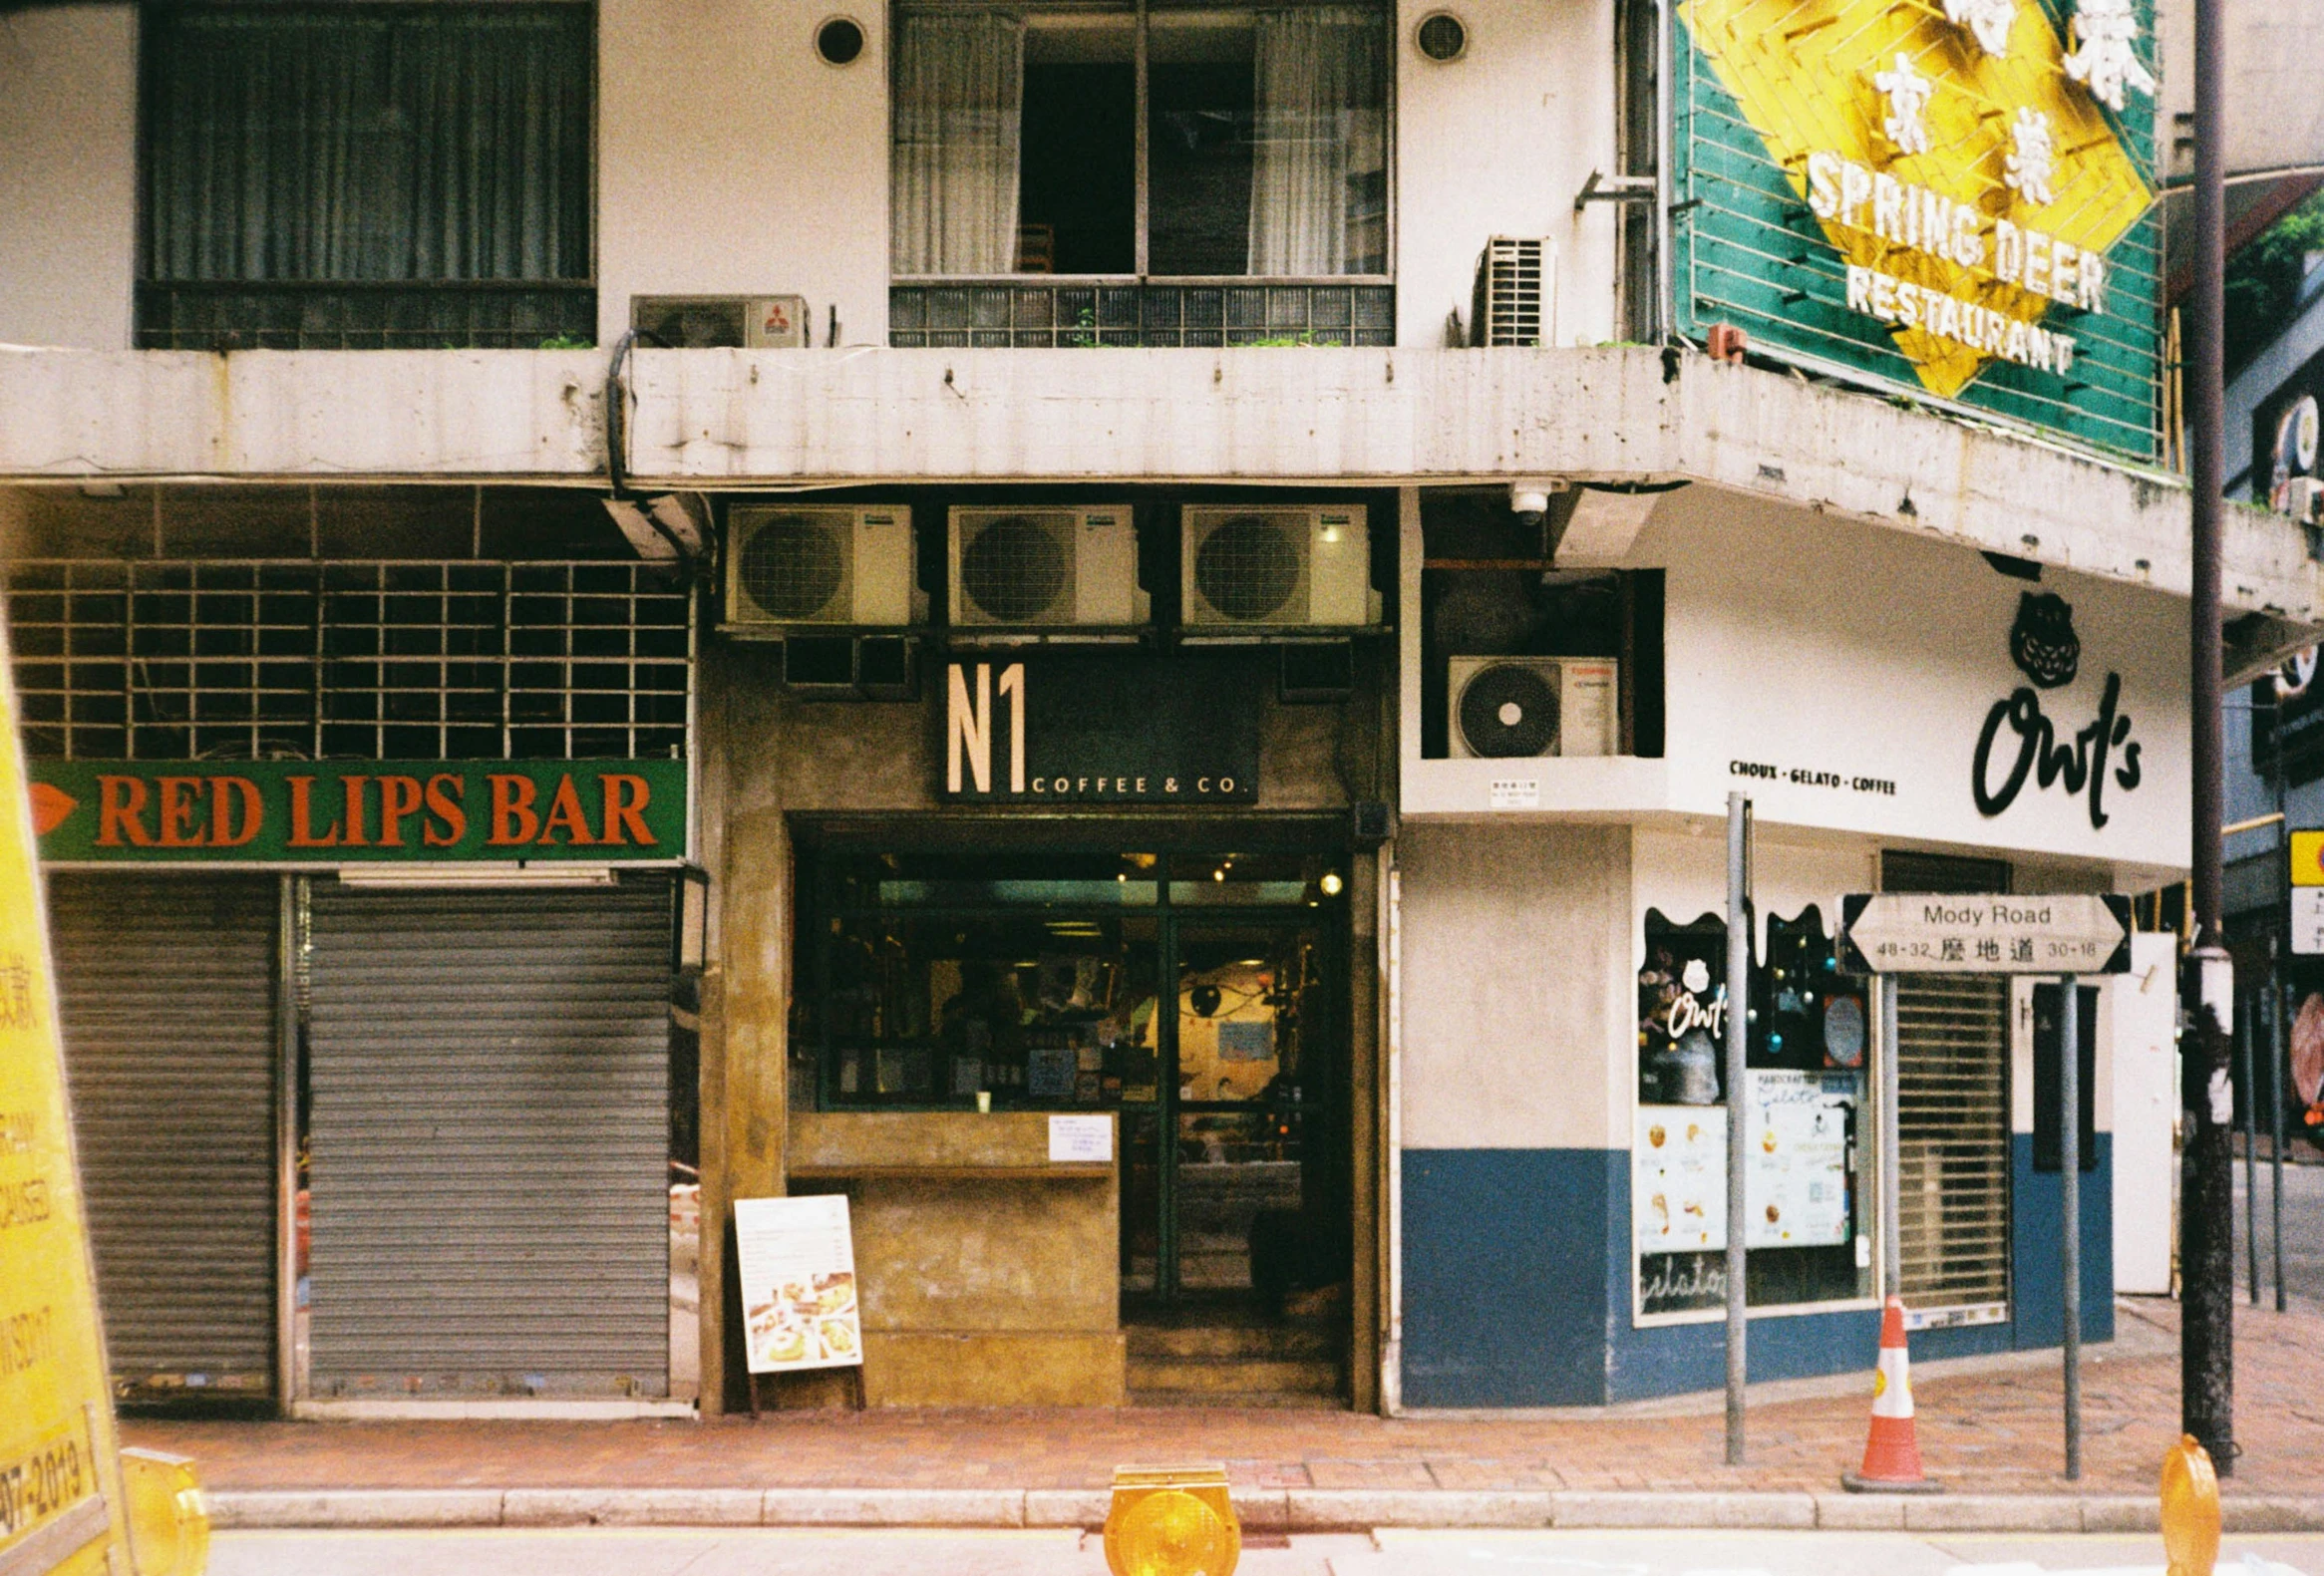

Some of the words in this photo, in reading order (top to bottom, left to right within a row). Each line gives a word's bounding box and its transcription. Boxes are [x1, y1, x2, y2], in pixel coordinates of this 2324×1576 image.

[1808, 150, 1985, 267] SPRING
[1996, 217, 2105, 314] DEER
[1847, 264, 2076, 376] RESTAURANT
[947, 663, 1025, 793] N1
[1032, 778, 1147, 793] COFFEE
[1165, 778, 1179, 793] &
[1197, 778, 1248, 793] CO.
[1972, 672, 2142, 829] Owl's
[95, 775, 263, 848] RED
[286, 774, 467, 848] LIPS
[487, 773, 658, 846] BAR
[1729, 760, 1777, 780] CHOUX
[1790, 769, 1840, 788] GELATO
[1851, 777, 1896, 795] COFFEE
[1876, 942, 1931, 957] 48-32
[1923, 905, 1983, 926] Mody
[1992, 905, 2051, 924] Road
